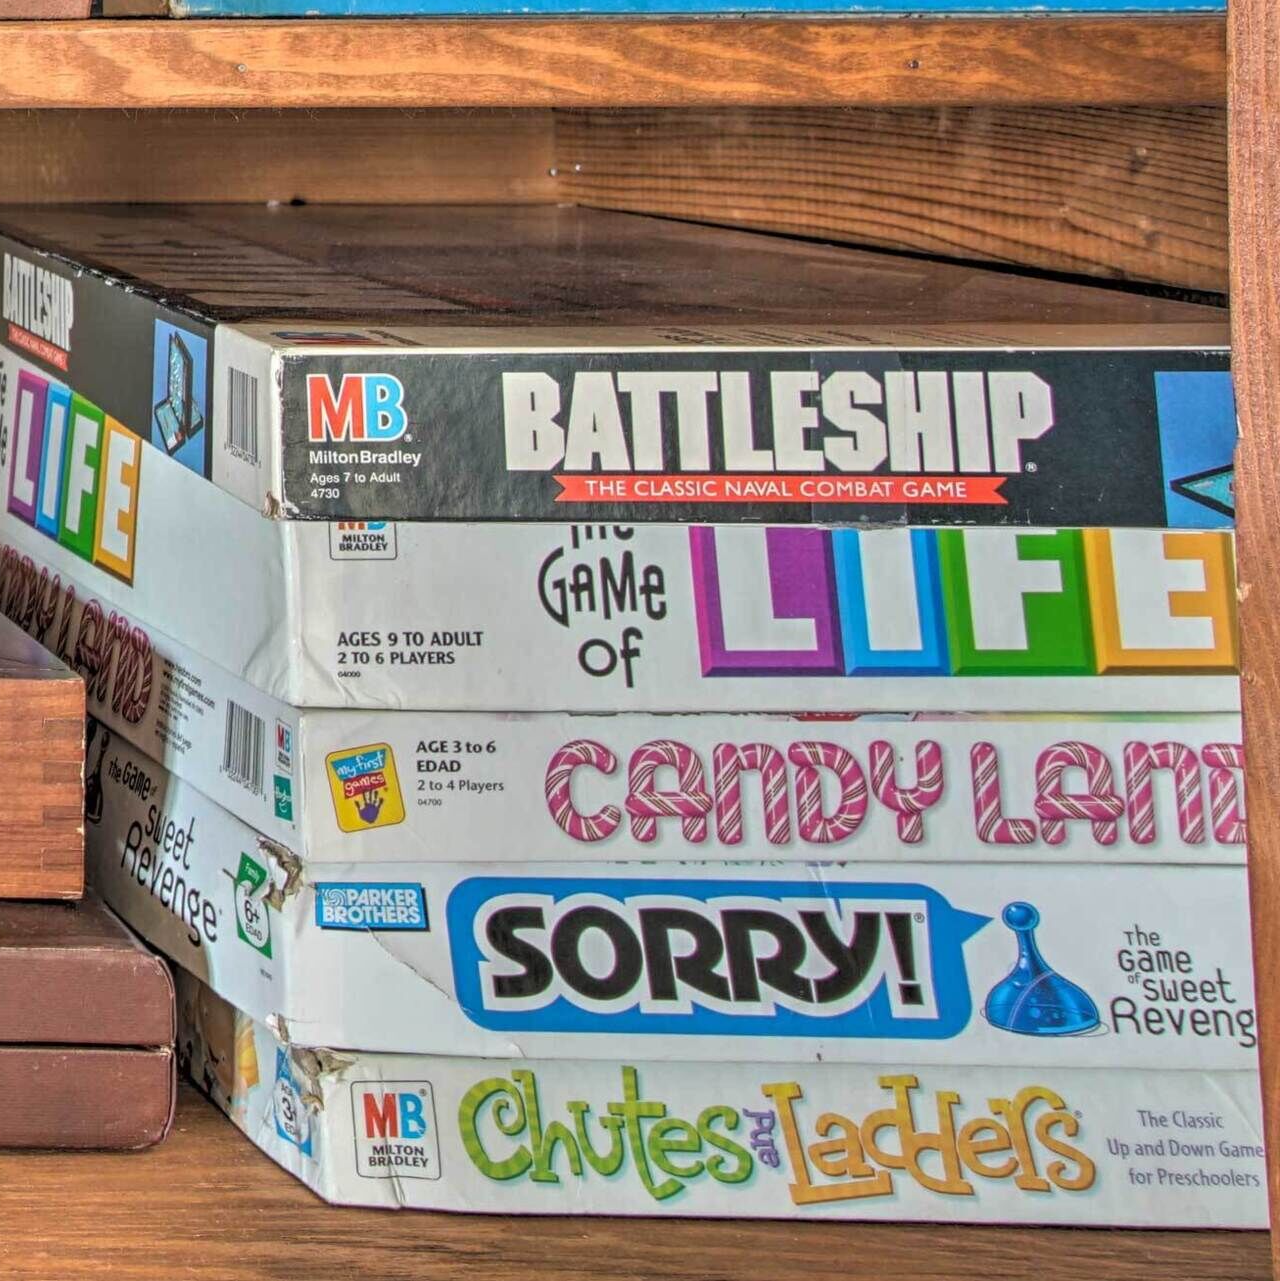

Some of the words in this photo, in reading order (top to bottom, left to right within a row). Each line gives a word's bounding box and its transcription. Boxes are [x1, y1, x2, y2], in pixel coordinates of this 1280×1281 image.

[307, 374, 407, 441] MB
[502, 371, 1053, 473] BATTLESHIP
[311, 489, 339, 498] 4730
[585, 481, 628, 496] THE
[634, 481, 717, 497] CLASSIC
[724, 481, 793, 497] NAVAL
[800, 481, 894, 498] COMBAT
[902, 482, 967, 498] GAME
[416, 759, 461, 773] EDAD
[545, 739, 945, 845] CANDY
[345, 889, 417, 907] PARKER
[323, 906, 420, 925] BROTHERS
[1124, 925, 1160, 947] The
[485, 905, 923, 1005] SORRY!
[1118, 948, 1191, 974] Game
[1128, 973, 1141, 984] of
[1110, 996, 1258, 1048] Reveng
[364, 1092, 427, 1139] MB
[1138, 1111, 1168, 1128] The
[1173, 1111, 1224, 1129] Classic
[458, 1065, 753, 1200] Chutes
[742, 1107, 782, 1170] and
[762, 1074, 1095, 1205] Ladders
[373, 1145, 424, 1155] MILTON
[368, 1156, 428, 1168] BRADLEY
[1129, 1166, 1153, 1185] for
[1157, 1169, 1260, 1187] Preschoolers
